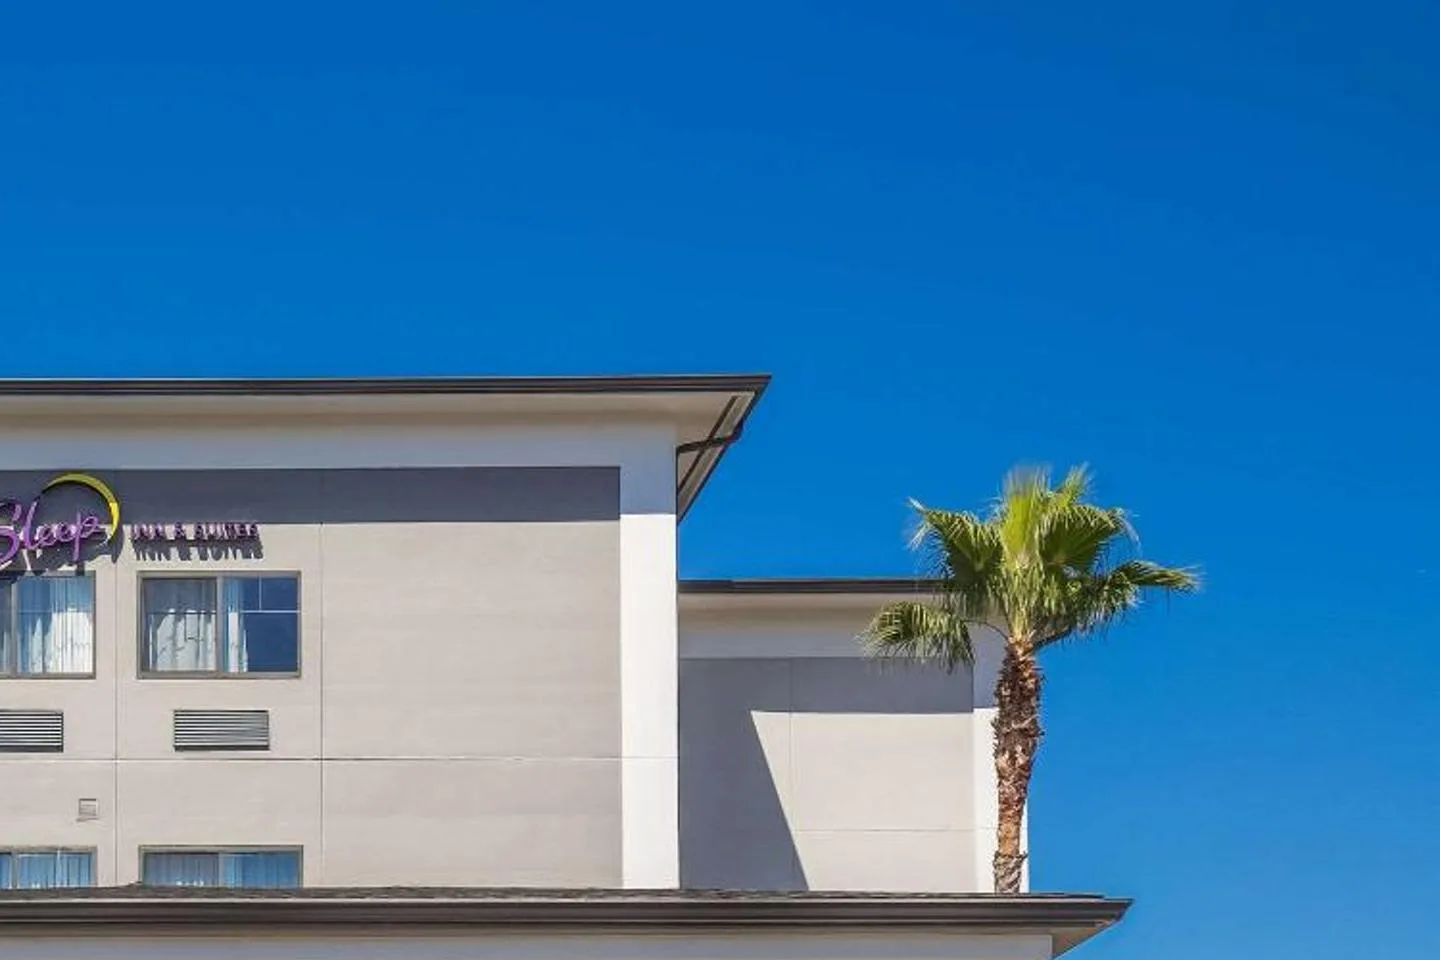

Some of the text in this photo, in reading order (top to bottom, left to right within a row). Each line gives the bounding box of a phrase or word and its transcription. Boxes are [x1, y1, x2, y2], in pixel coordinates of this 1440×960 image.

[132, 522, 165, 540] INN
[174, 522, 187, 540] &
[194, 522, 259, 540] SUITES
